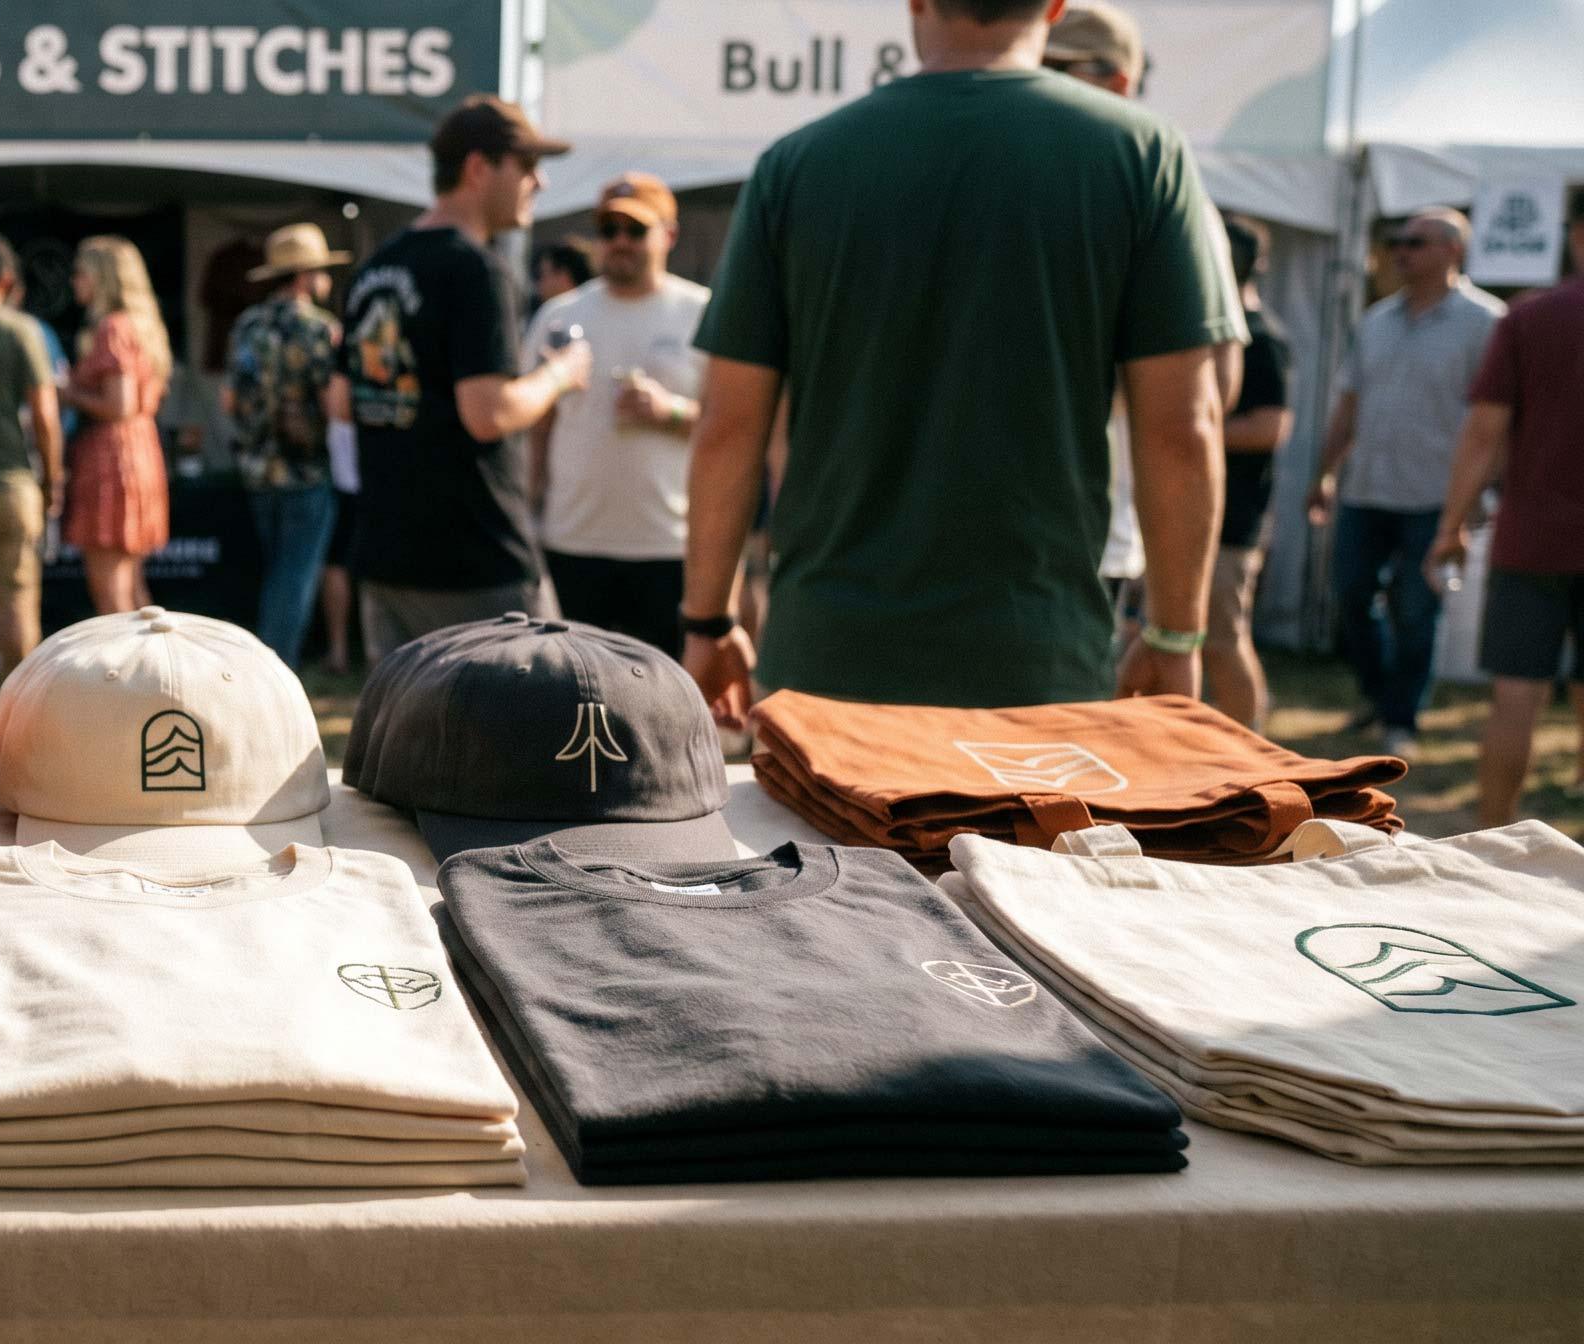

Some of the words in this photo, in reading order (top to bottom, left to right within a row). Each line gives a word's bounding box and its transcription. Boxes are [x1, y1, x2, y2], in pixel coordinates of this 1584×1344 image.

[18, 24, 83, 95] &
[98, 24, 456, 97] STITCHES
[723, 37, 843, 93] Bull
